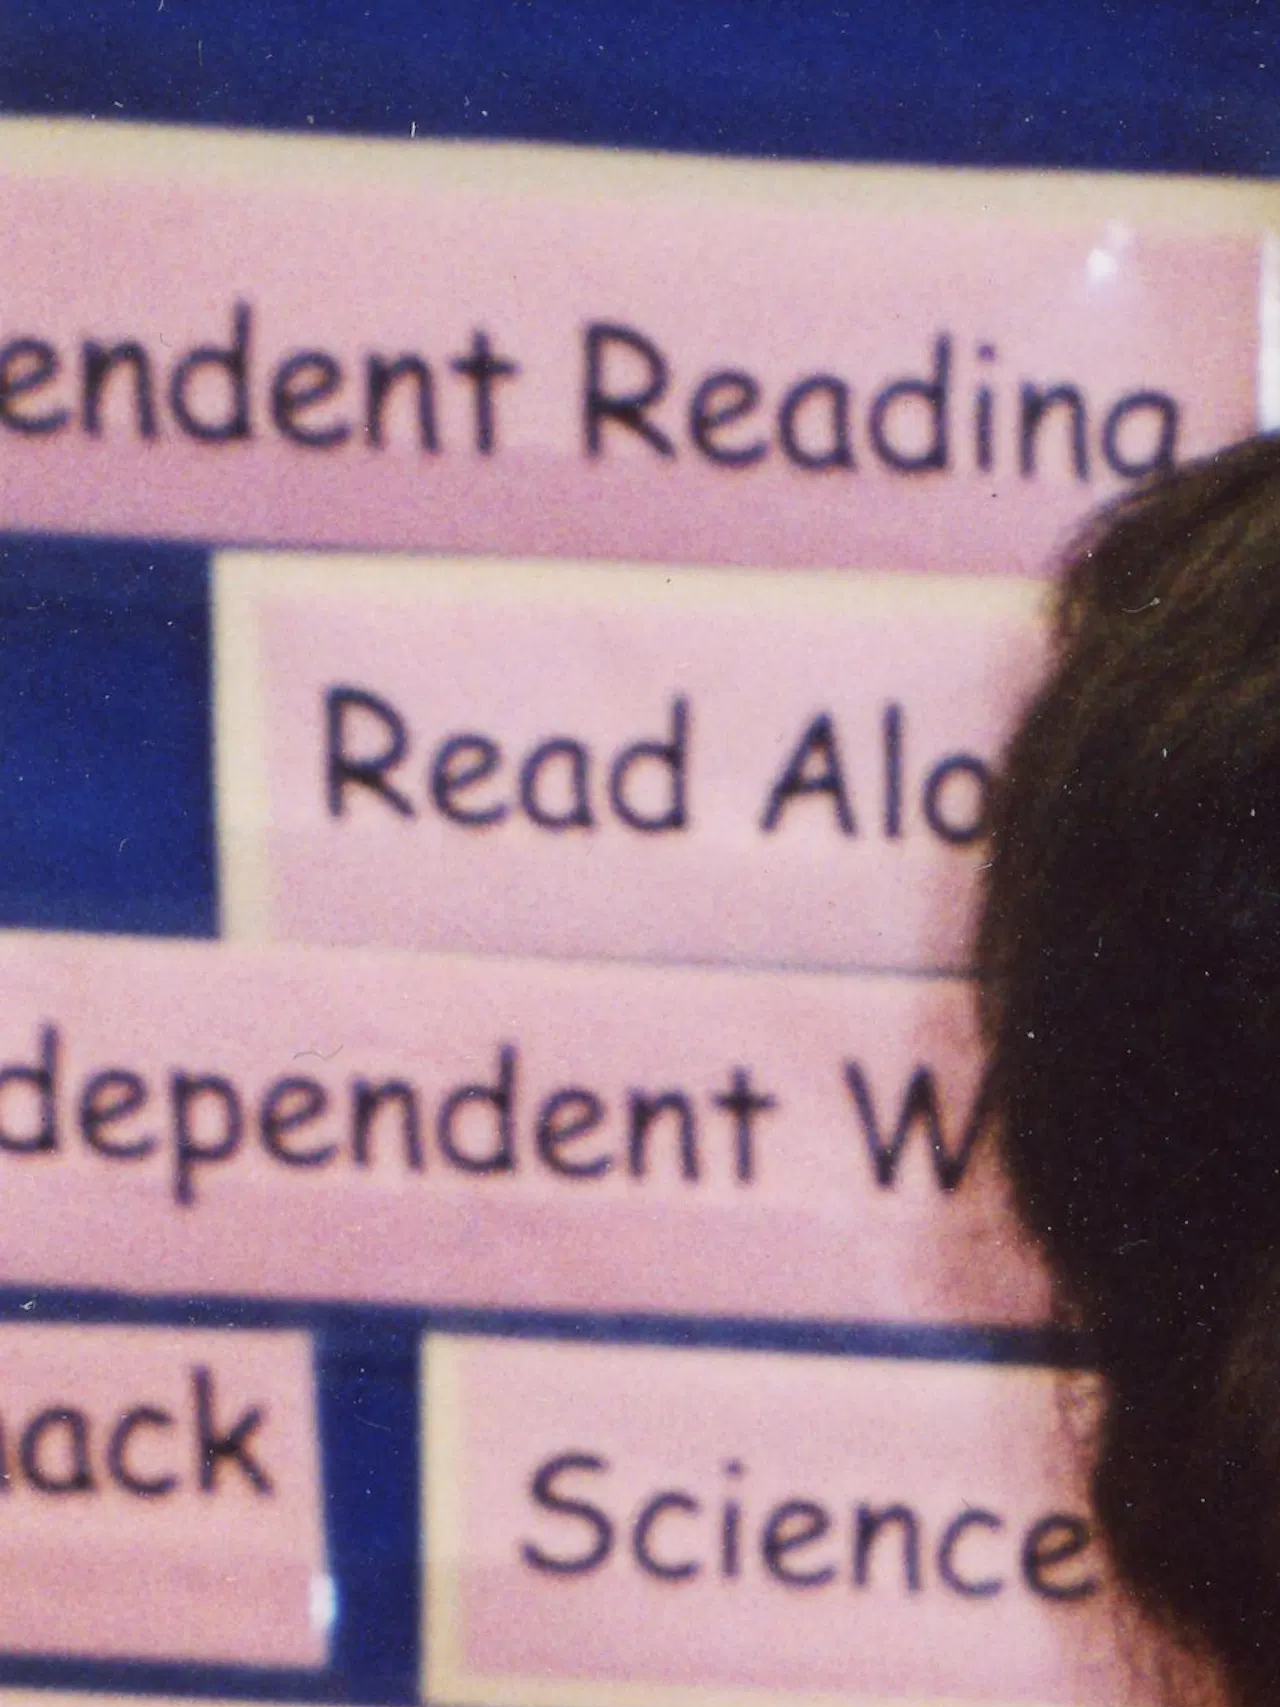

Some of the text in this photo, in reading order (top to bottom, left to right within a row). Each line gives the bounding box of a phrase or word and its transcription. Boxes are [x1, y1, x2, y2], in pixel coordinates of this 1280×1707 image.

[0, 297, 515, 453] endent
[322, 684, 992, 845] Read Alo
[0, 1018, 777, 1205] dependent
[0, 1362, 273, 1496] ack
[520, 1450, 1097, 1602] Science
